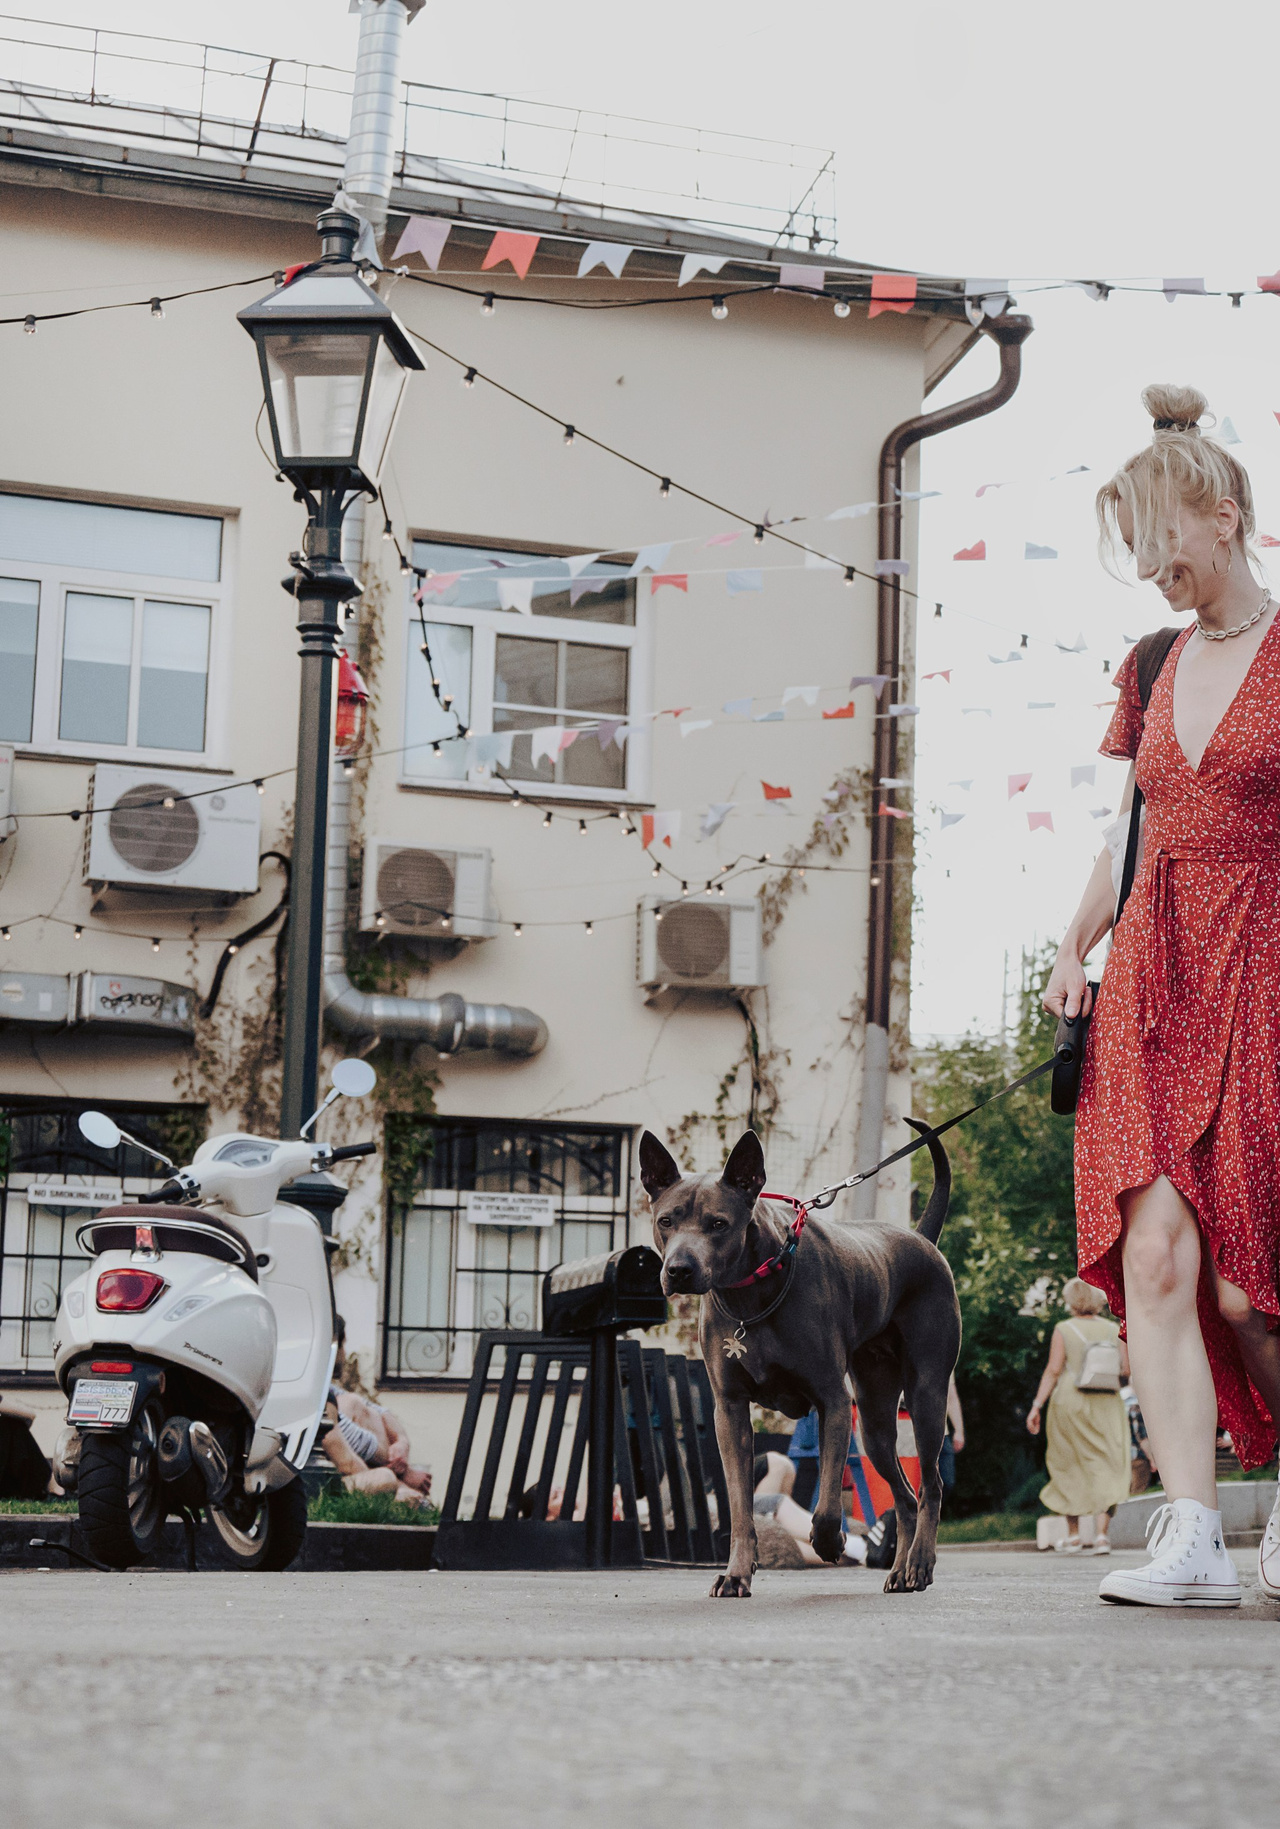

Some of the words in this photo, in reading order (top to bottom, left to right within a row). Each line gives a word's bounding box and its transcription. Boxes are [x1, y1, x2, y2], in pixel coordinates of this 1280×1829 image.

[34, 1189, 47, 1198] NO
[50, 1190, 91, 1200] SMOKING
[94, 1192, 117, 1201] AREA
[104, 1407, 129, 1420] 777
